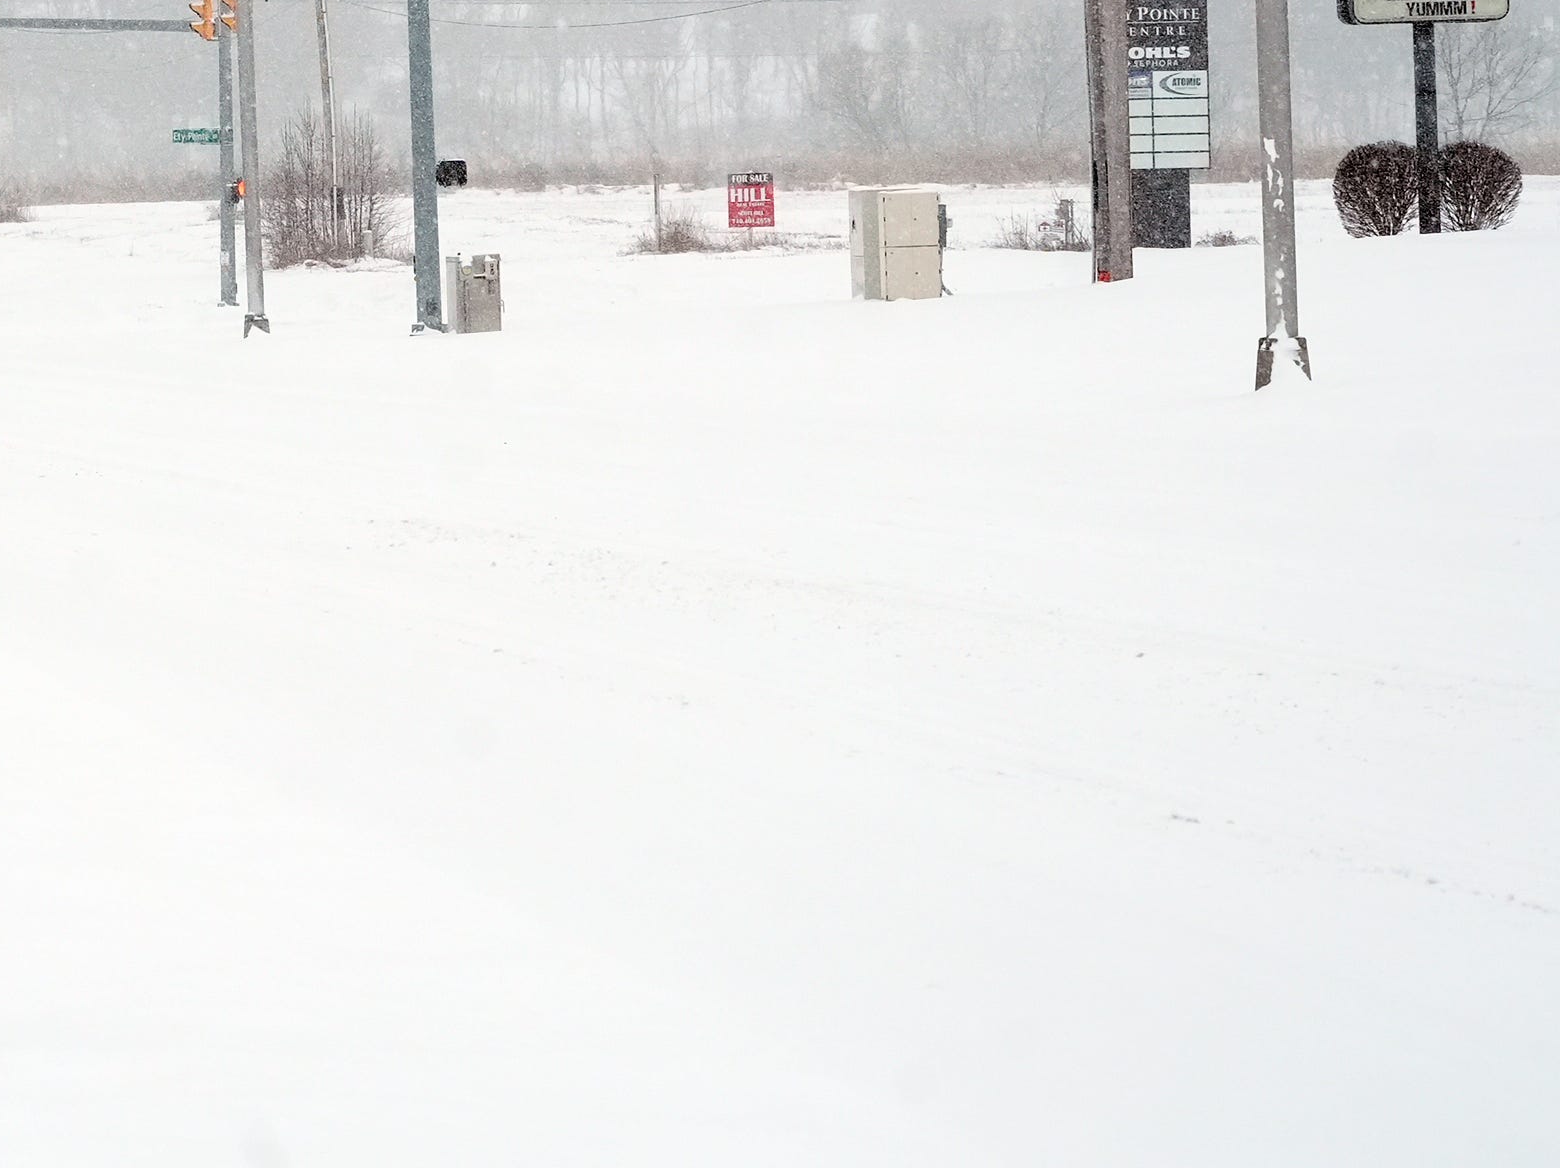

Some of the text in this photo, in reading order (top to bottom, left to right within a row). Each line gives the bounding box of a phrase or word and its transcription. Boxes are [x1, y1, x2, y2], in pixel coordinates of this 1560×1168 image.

[1136, 6, 1200, 21] POINTE
[1129, 26, 1186, 37] ENTRE
[1128, 46, 1191, 59] OHL'S
[1133, 59, 1179, 68] SEPHORA
[1171, 77, 1201, 87] ATOMIC
[731, 173, 769, 183] FOR SALE
[730, 186, 771, 202] HILL
